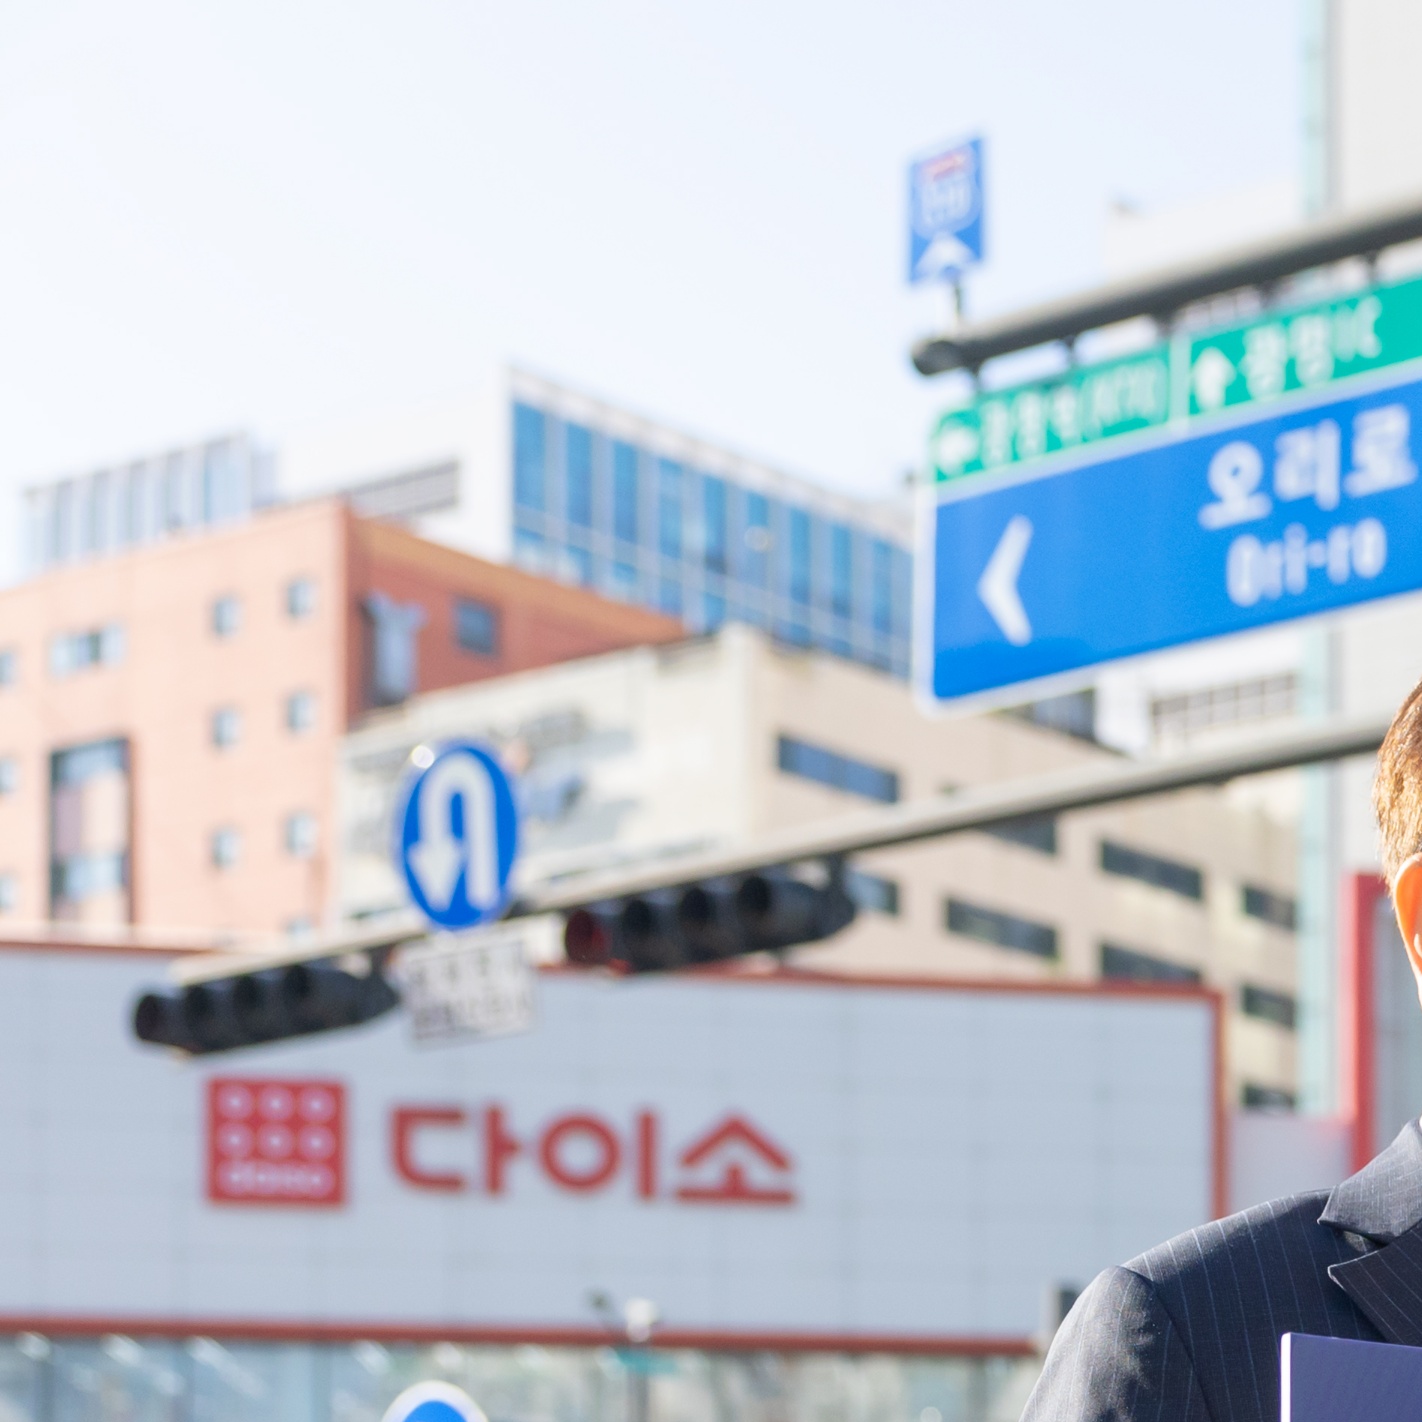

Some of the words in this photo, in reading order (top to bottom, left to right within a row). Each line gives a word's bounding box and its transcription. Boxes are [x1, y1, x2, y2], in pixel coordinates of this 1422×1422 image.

[1199, 404, 1418, 531] 오리로
[1226, 517, 1387, 607] Ori-ro
[390, 1104, 798, 1206] 다이소
